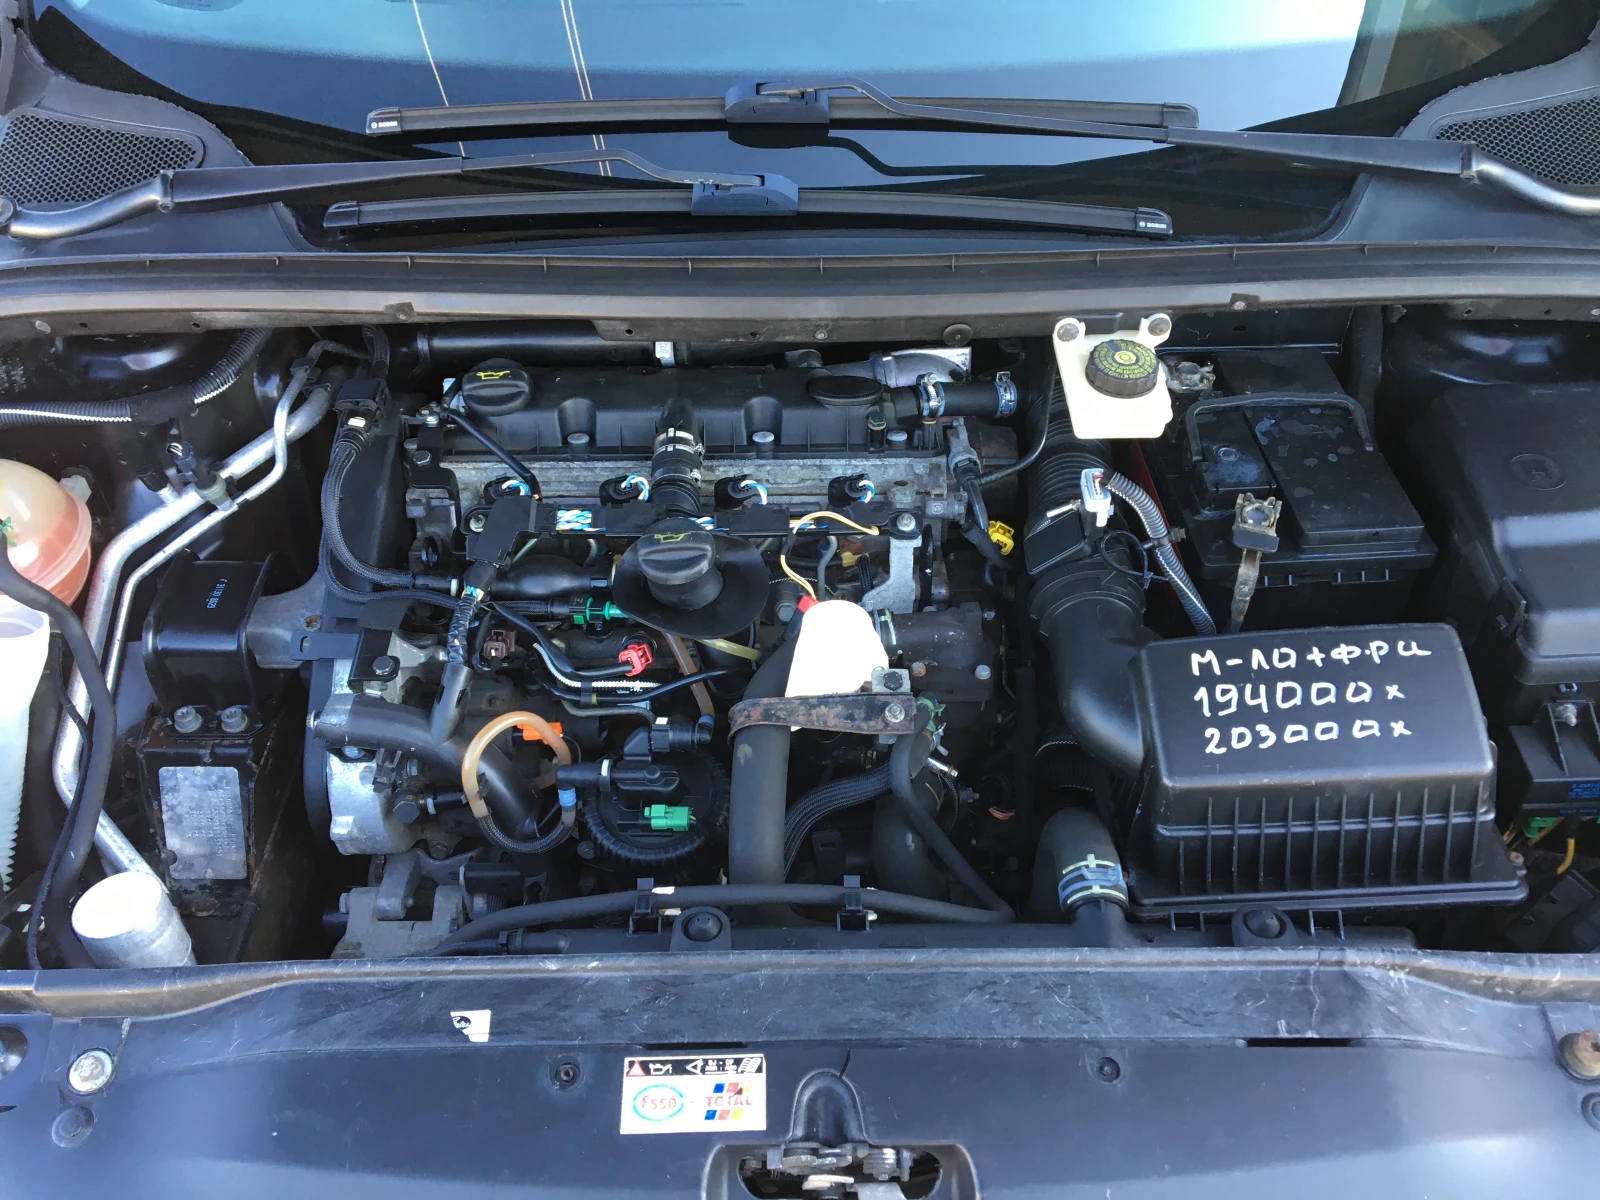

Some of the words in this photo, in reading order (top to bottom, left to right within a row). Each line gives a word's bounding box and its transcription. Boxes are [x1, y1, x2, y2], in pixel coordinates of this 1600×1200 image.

[1193, 681, 1373, 717] 194000
[1204, 719, 1381, 755] 203000
[705, 1095, 752, 1107] TOTAL
